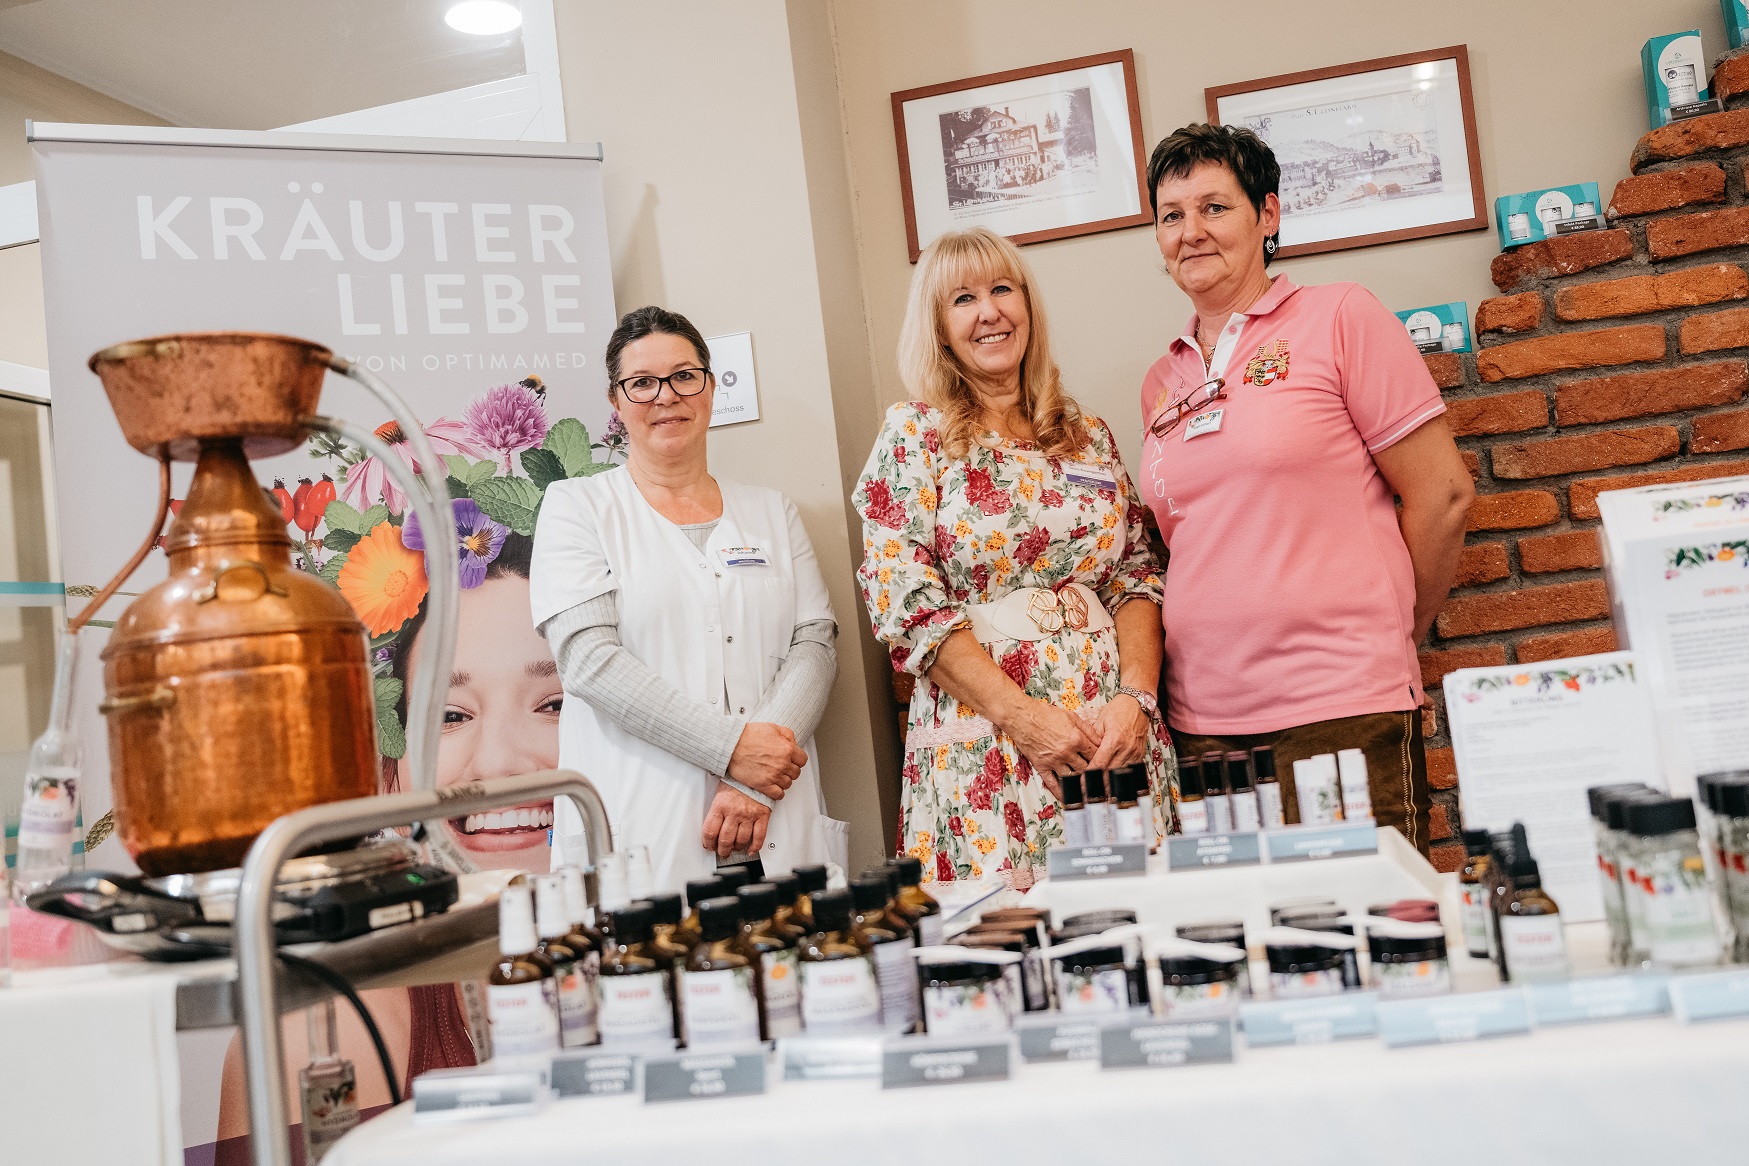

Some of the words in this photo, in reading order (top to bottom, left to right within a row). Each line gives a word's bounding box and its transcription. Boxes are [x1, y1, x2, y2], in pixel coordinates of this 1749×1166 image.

[136, 181, 578, 264] KRÄUTER
[337, 273, 586, 336] LIEBE
[422, 352, 587, 371] OPTIMAMED
[712, 405, 745, 416] eschoss
